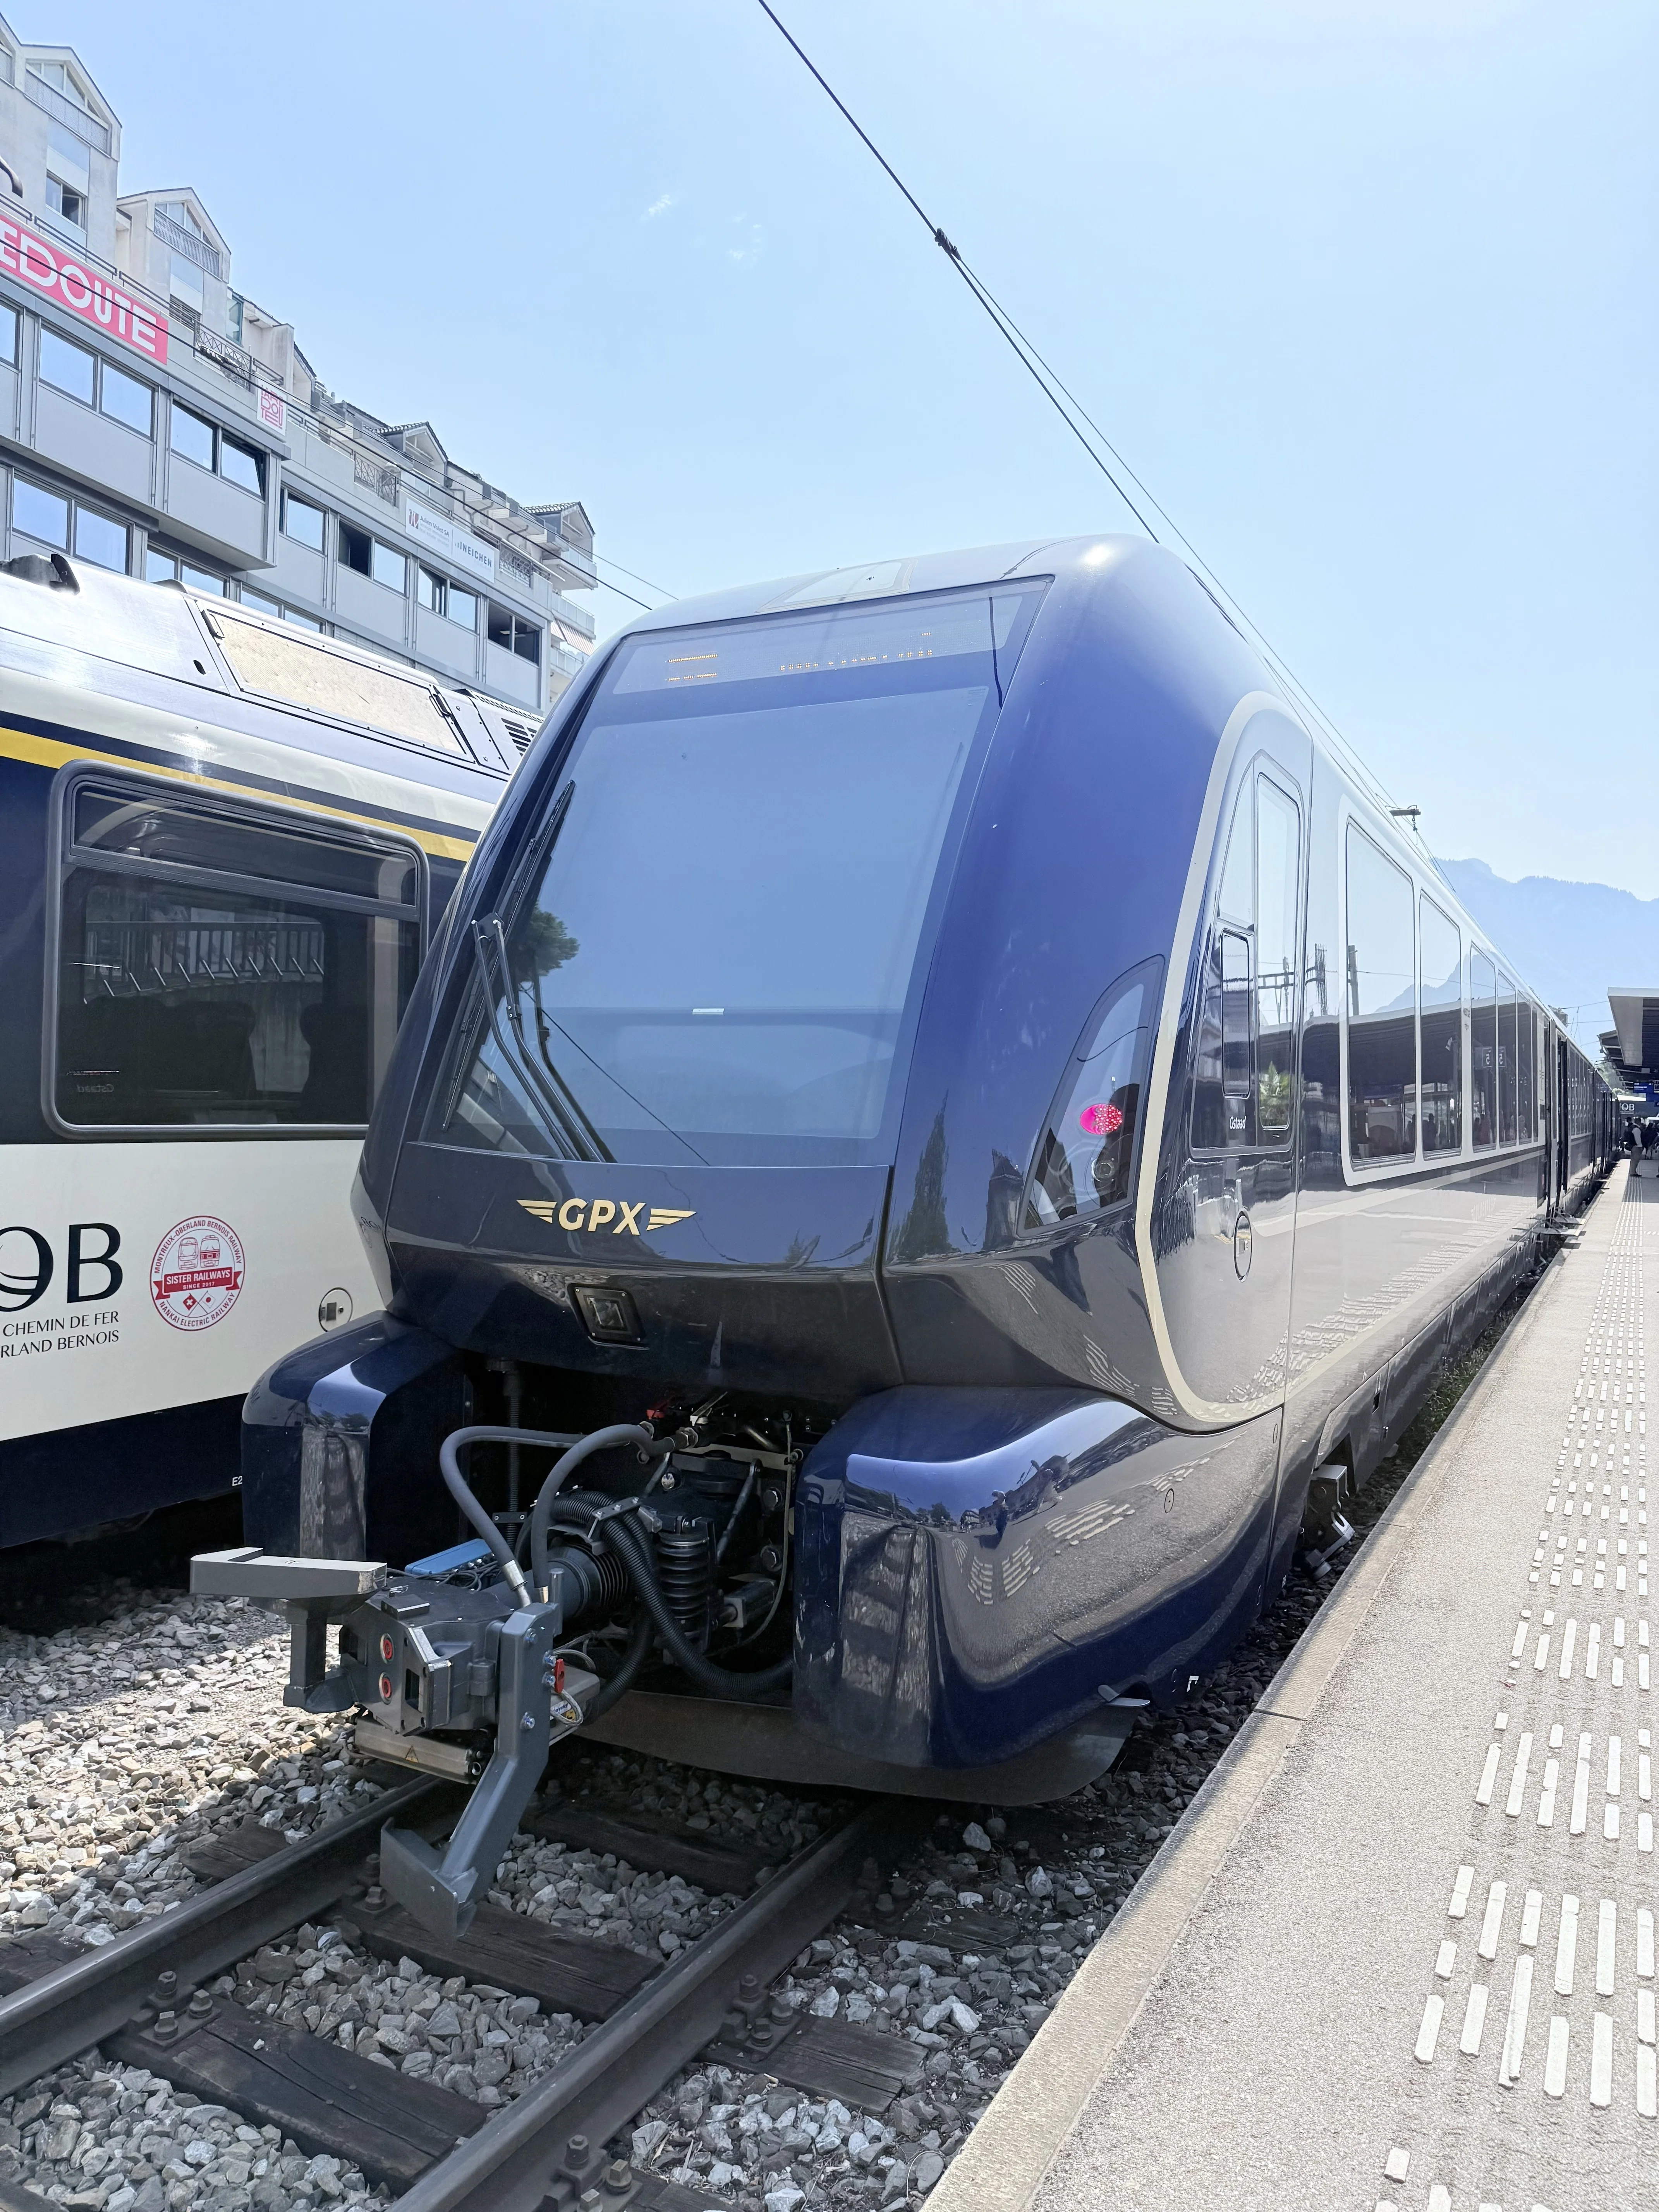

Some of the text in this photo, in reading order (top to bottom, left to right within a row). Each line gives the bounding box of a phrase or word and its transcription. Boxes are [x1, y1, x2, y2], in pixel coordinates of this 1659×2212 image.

[420, 516, 432, 526] Julien
[433, 523, 443, 534] Volet
[460, 541, 492, 567] INEICHEN
[1229, 1116, 1246, 1129] Gstaad
[558, 1198, 646, 1235] GPX
[207, 1221, 230, 1237] BERNOIS
[228, 1235, 242, 1264] RAILWAY
[167, 1269, 230, 1285] SISTER RAILWAYS
[159, 1292, 235, 1327] NANKAI ELECTRIC RAILWAY
[3, 1311, 119, 1337] CHEMIN DE FER
[1, 1330, 119, 1358] RLAND BERNOIS
